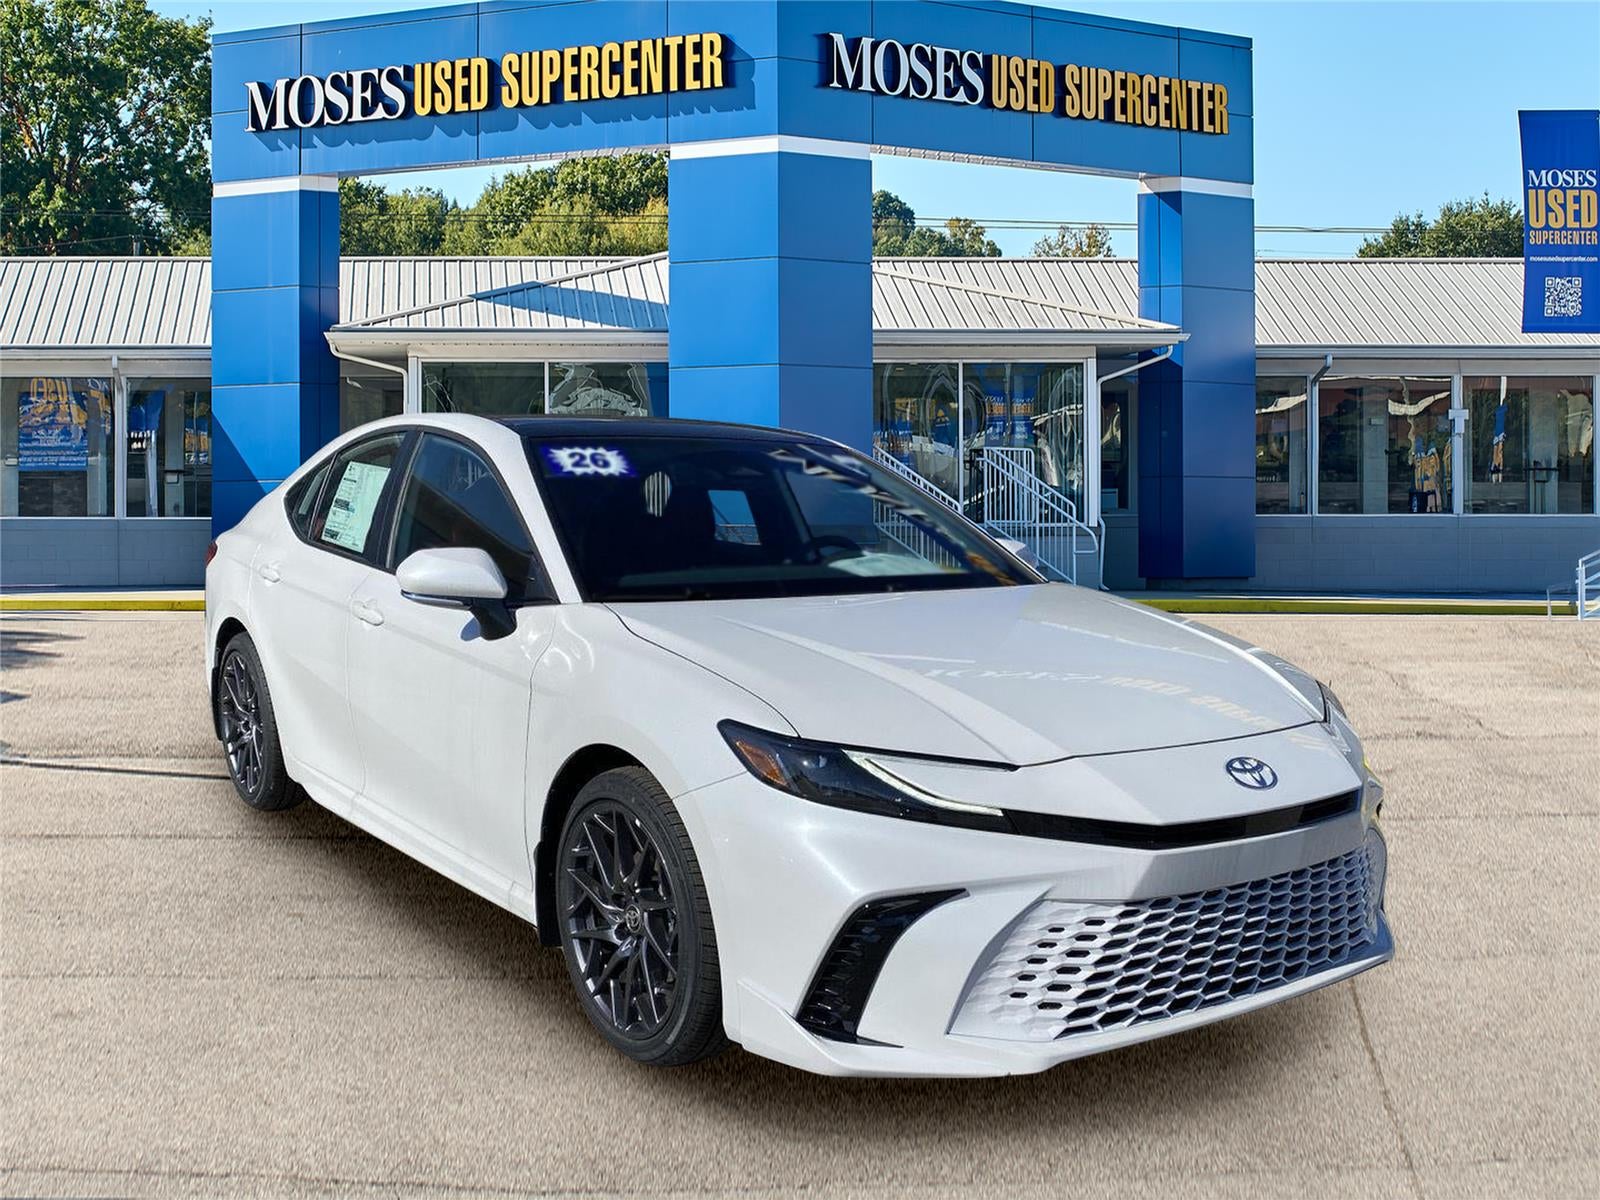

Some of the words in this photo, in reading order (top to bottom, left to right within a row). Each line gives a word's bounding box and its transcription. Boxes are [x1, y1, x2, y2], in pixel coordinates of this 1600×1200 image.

[244, 65, 406, 132] MOSES
[414, 57, 488, 115] USED
[501, 32, 723, 108] SUPERCENTER
[828, 32, 984, 105] MOSES
[991, 54, 1055, 113] USED
[1065, 64, 1229, 134] SUPERCENTER
[1528, 170, 1597, 187] MOSES
[1529, 190, 1597, 228] USED
[1530, 231, 1597, 245] SUPERCENTER
[568, 451, 610, 469] 26
